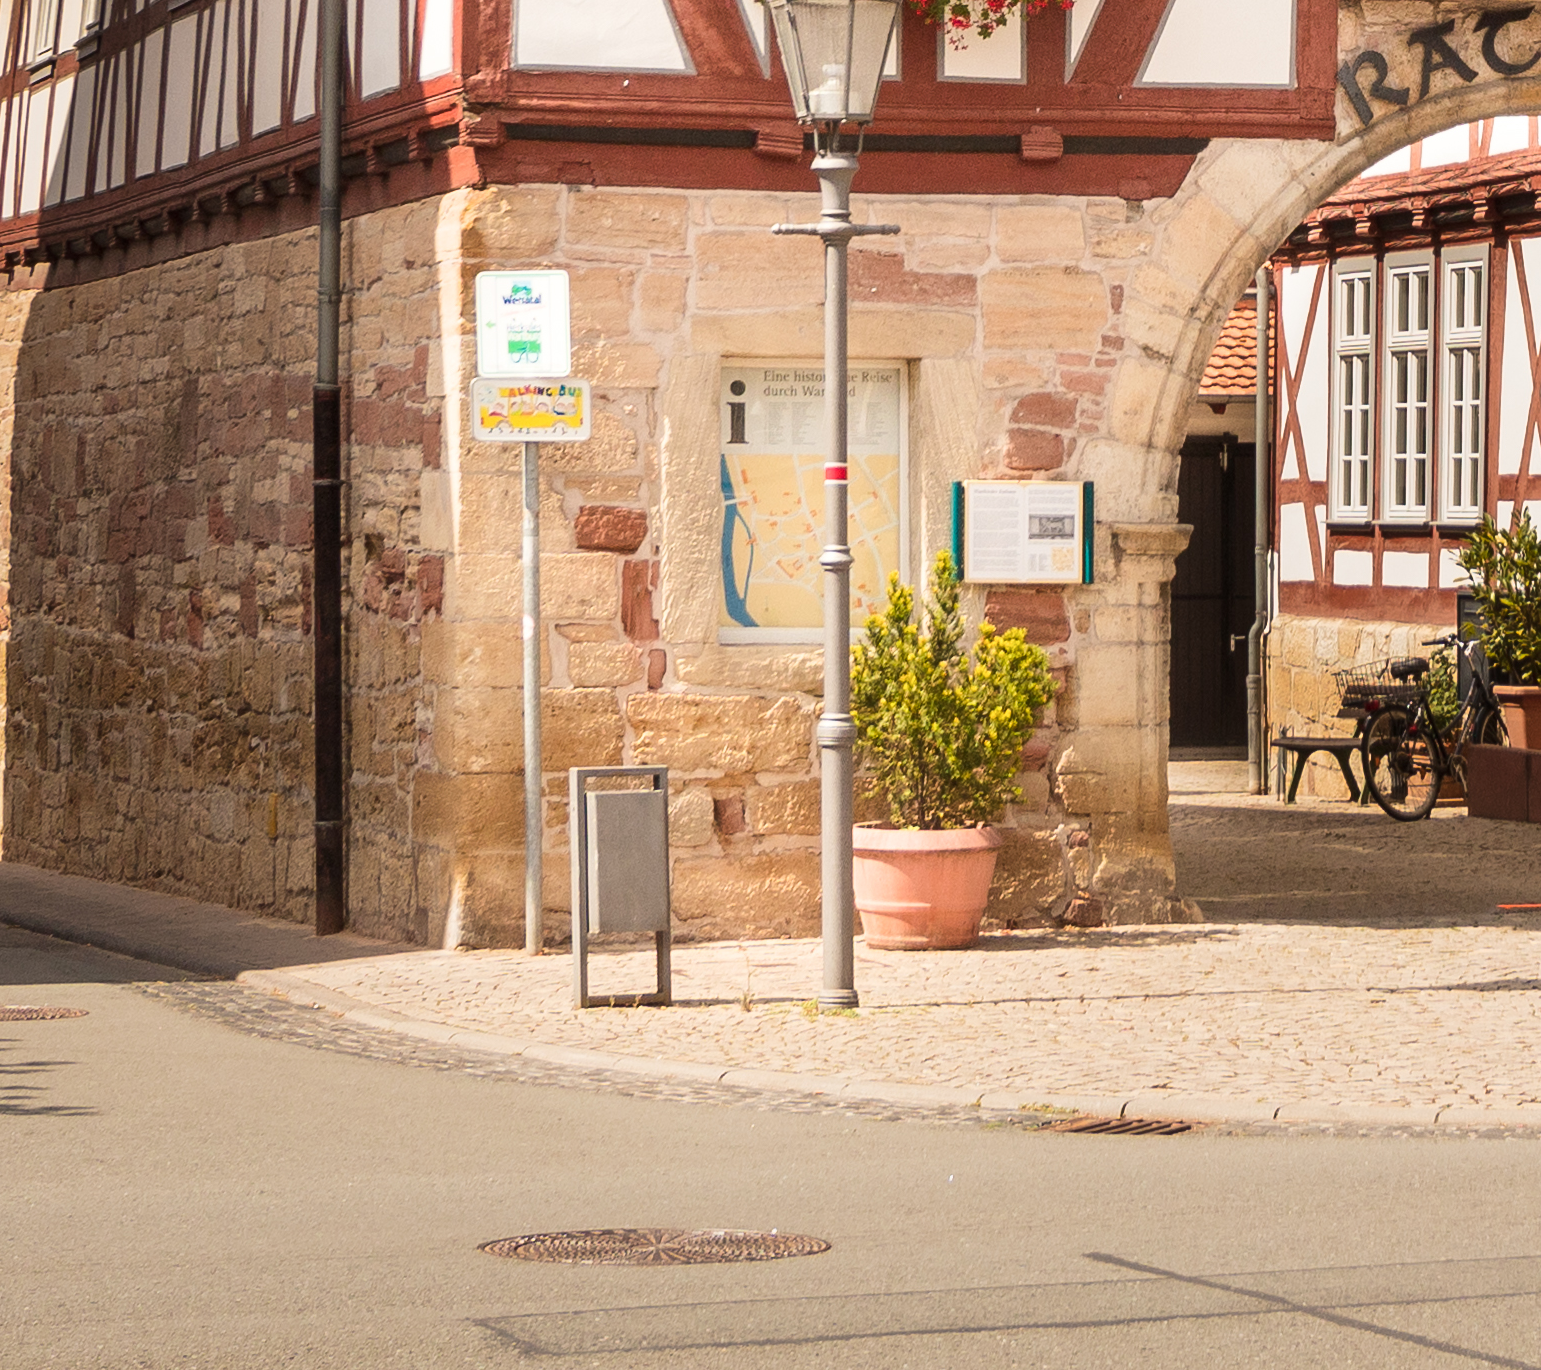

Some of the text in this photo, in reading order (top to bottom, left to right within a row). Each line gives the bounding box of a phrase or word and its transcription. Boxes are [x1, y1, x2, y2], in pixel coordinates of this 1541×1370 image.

[763, 370, 790, 382] Eine
[861, 371, 893, 383] Reise
[763, 385, 798, 397] durch
